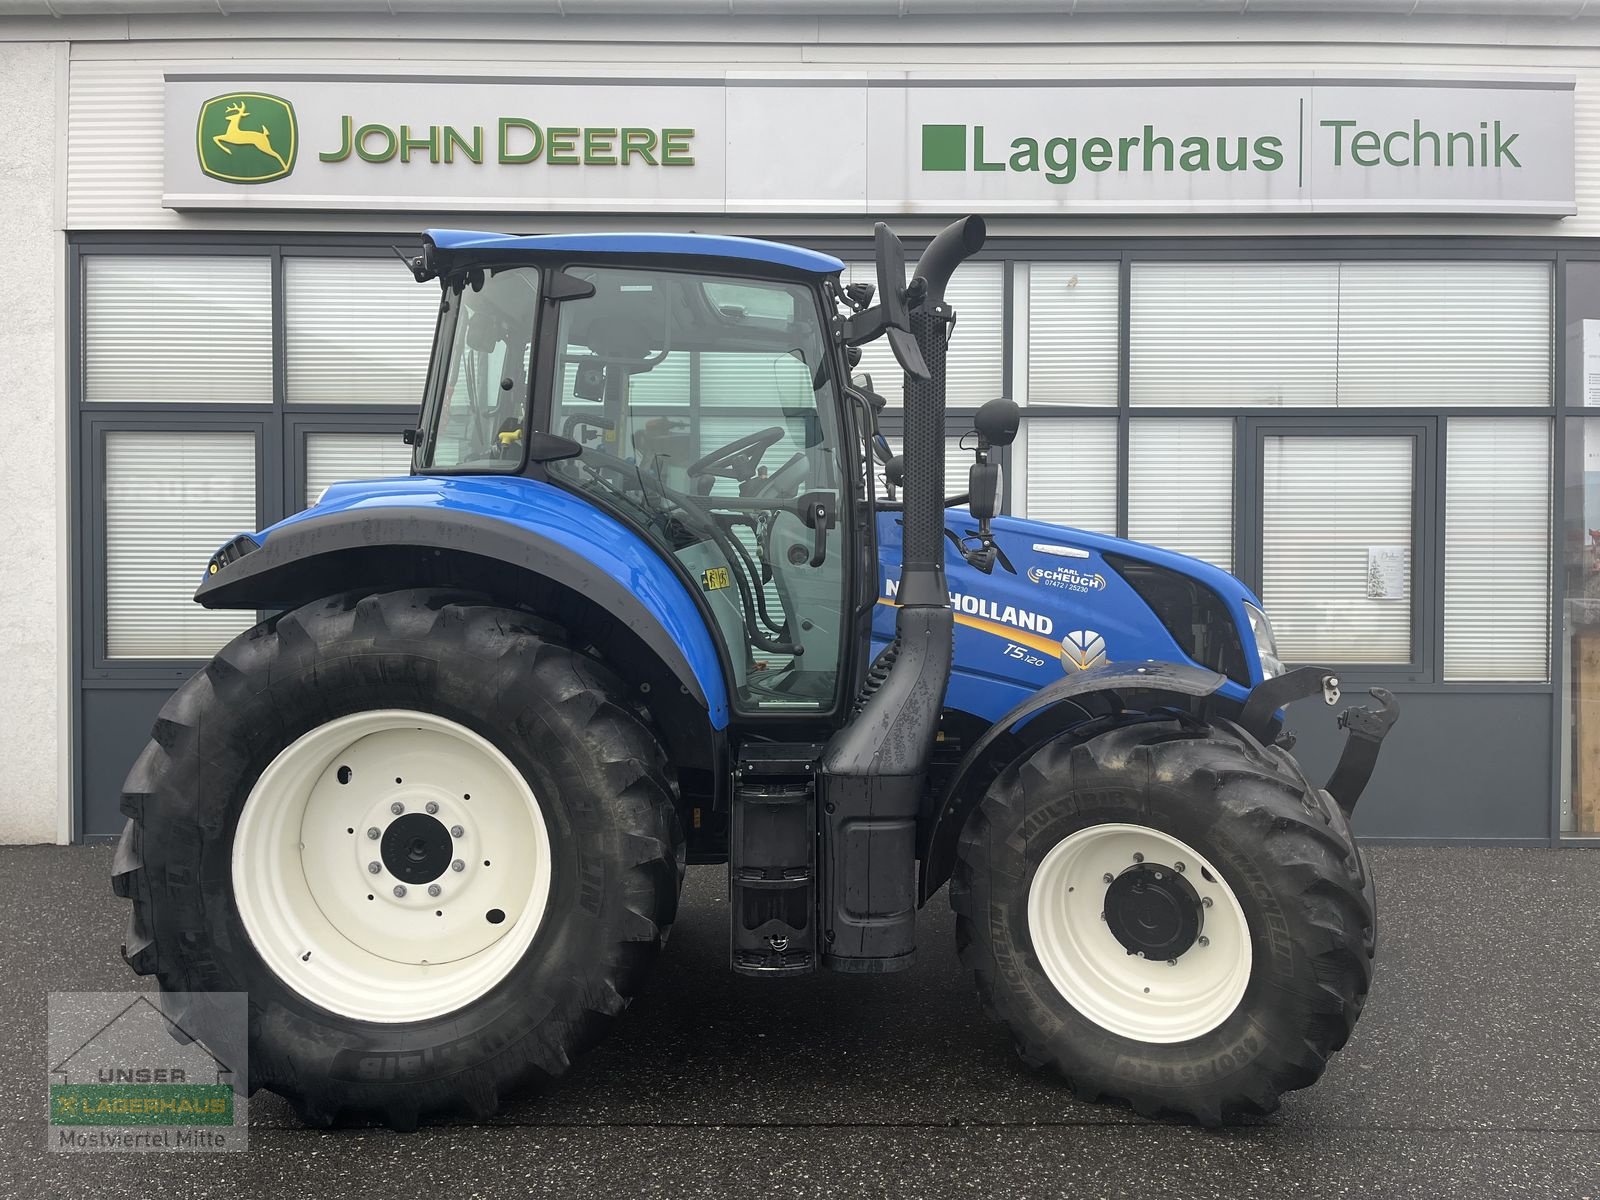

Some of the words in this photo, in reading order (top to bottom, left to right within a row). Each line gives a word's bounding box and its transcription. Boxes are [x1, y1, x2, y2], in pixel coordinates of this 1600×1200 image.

[318, 115, 483, 165] JOHN
[498, 116, 695, 166] DEERE
[972, 124, 1284, 185] Lagerhaus
[1319, 119, 1522, 169] Technik
[1035, 568, 1099, 588] SCHEUCH
[1057, 567, 1080, 576] KARL
[948, 591, 1053, 635] HOLLAND
